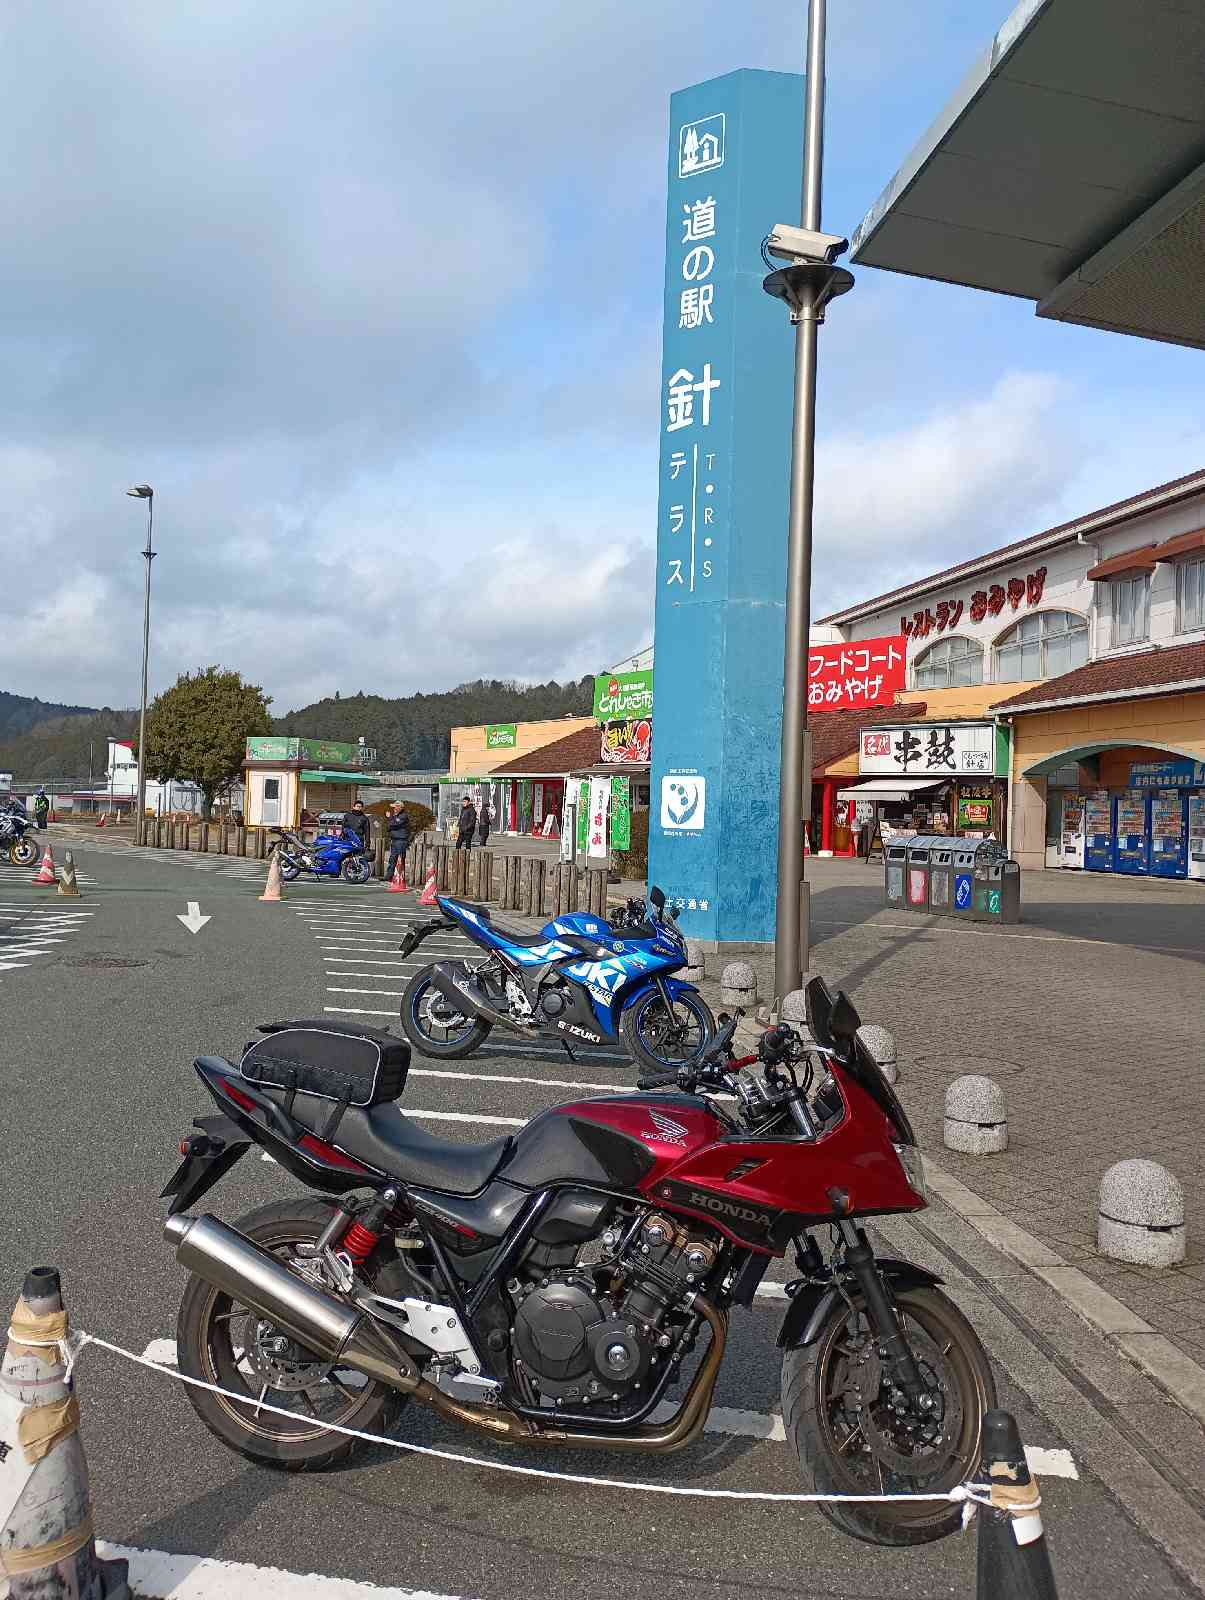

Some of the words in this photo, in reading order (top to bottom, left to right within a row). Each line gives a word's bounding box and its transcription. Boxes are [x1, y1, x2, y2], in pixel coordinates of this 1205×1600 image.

[679, 196, 718, 329] 道の駅
[666, 363, 721, 432] 針
[666, 451, 687, 585] テラス
[900, 599, 964, 638] レストラン
[969, 566, 1048, 622] おみやげ
[810, 645, 902, 677] フードコート
[808, 674, 884, 704] おみやげ
[557, 1020, 601, 1043] SUZUKI
[640, 1131, 688, 1148] HONDA
[690, 1192, 773, 1227] HONDA
